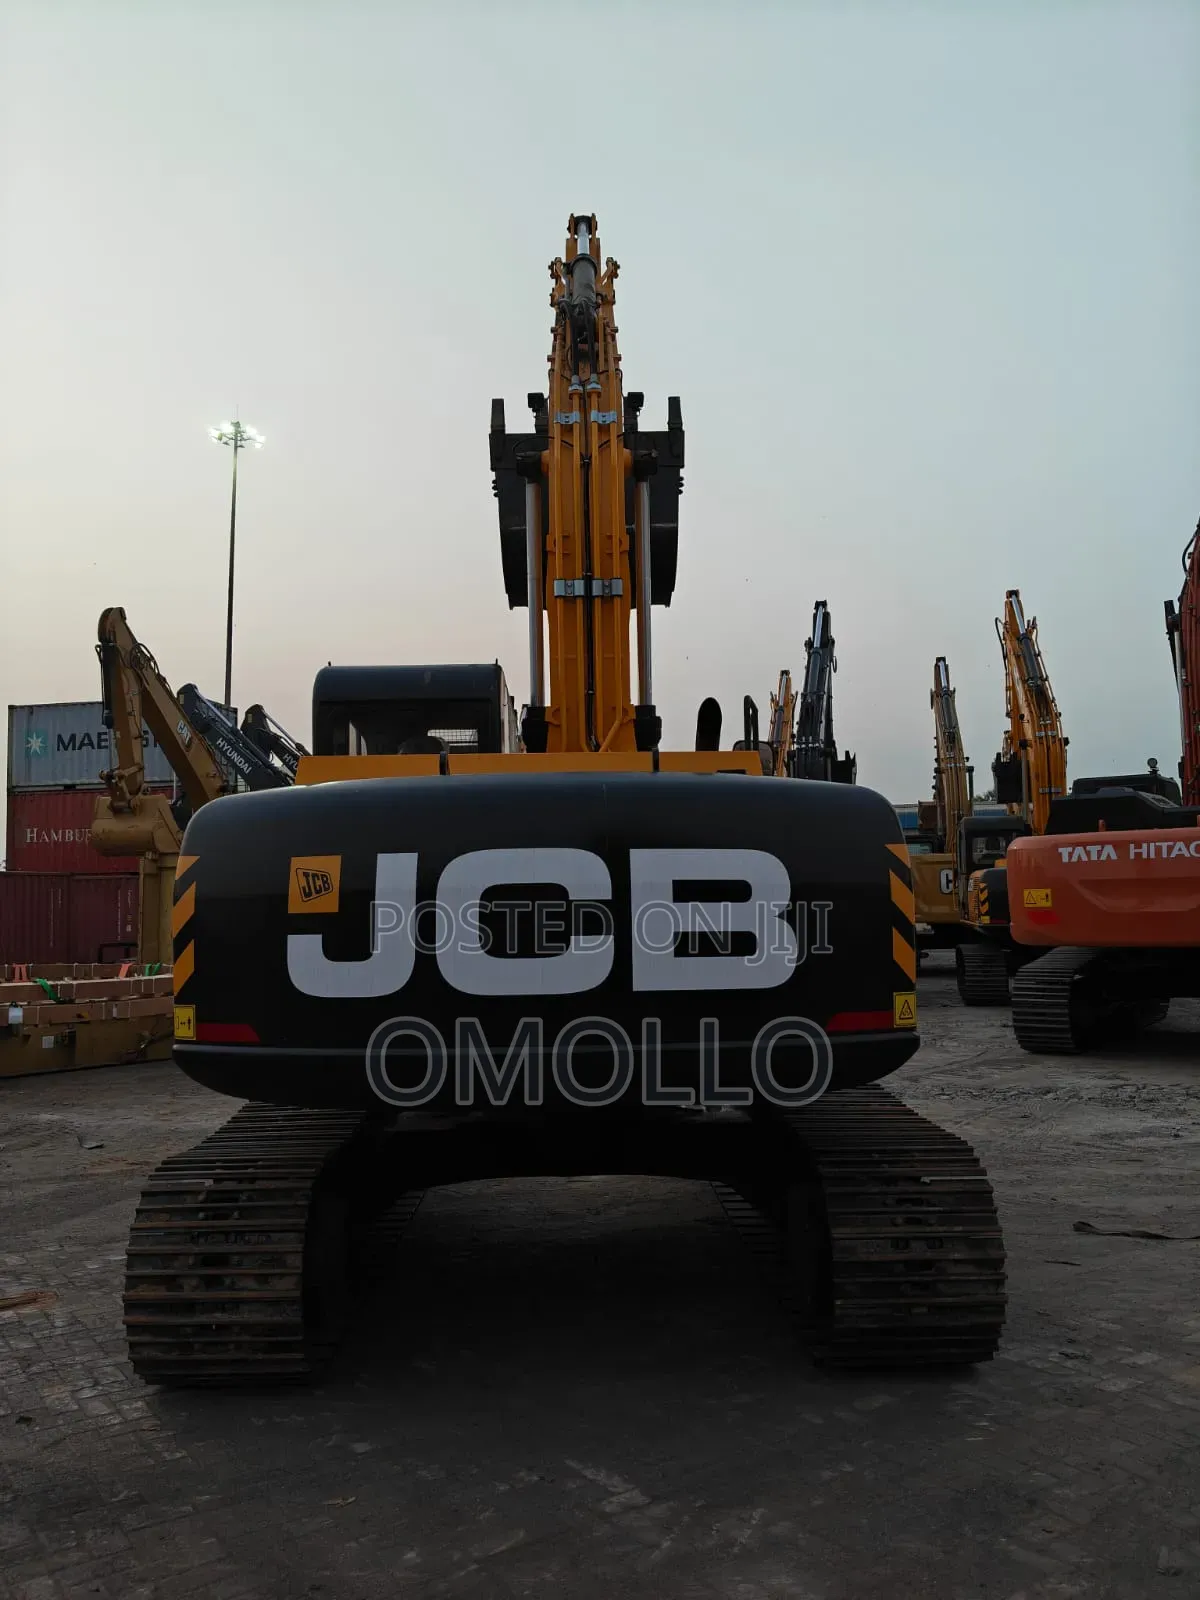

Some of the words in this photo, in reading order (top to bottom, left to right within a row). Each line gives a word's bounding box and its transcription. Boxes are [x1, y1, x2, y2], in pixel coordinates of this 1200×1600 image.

[56, 730, 158, 751] MAES
[176, 719, 193, 746] CAT
[216, 737, 253, 775] HYUNDAI
[1058, 844, 1118, 863] TATA
[301, 871, 331, 899] JCB
[286, 847, 798, 998] JCB
